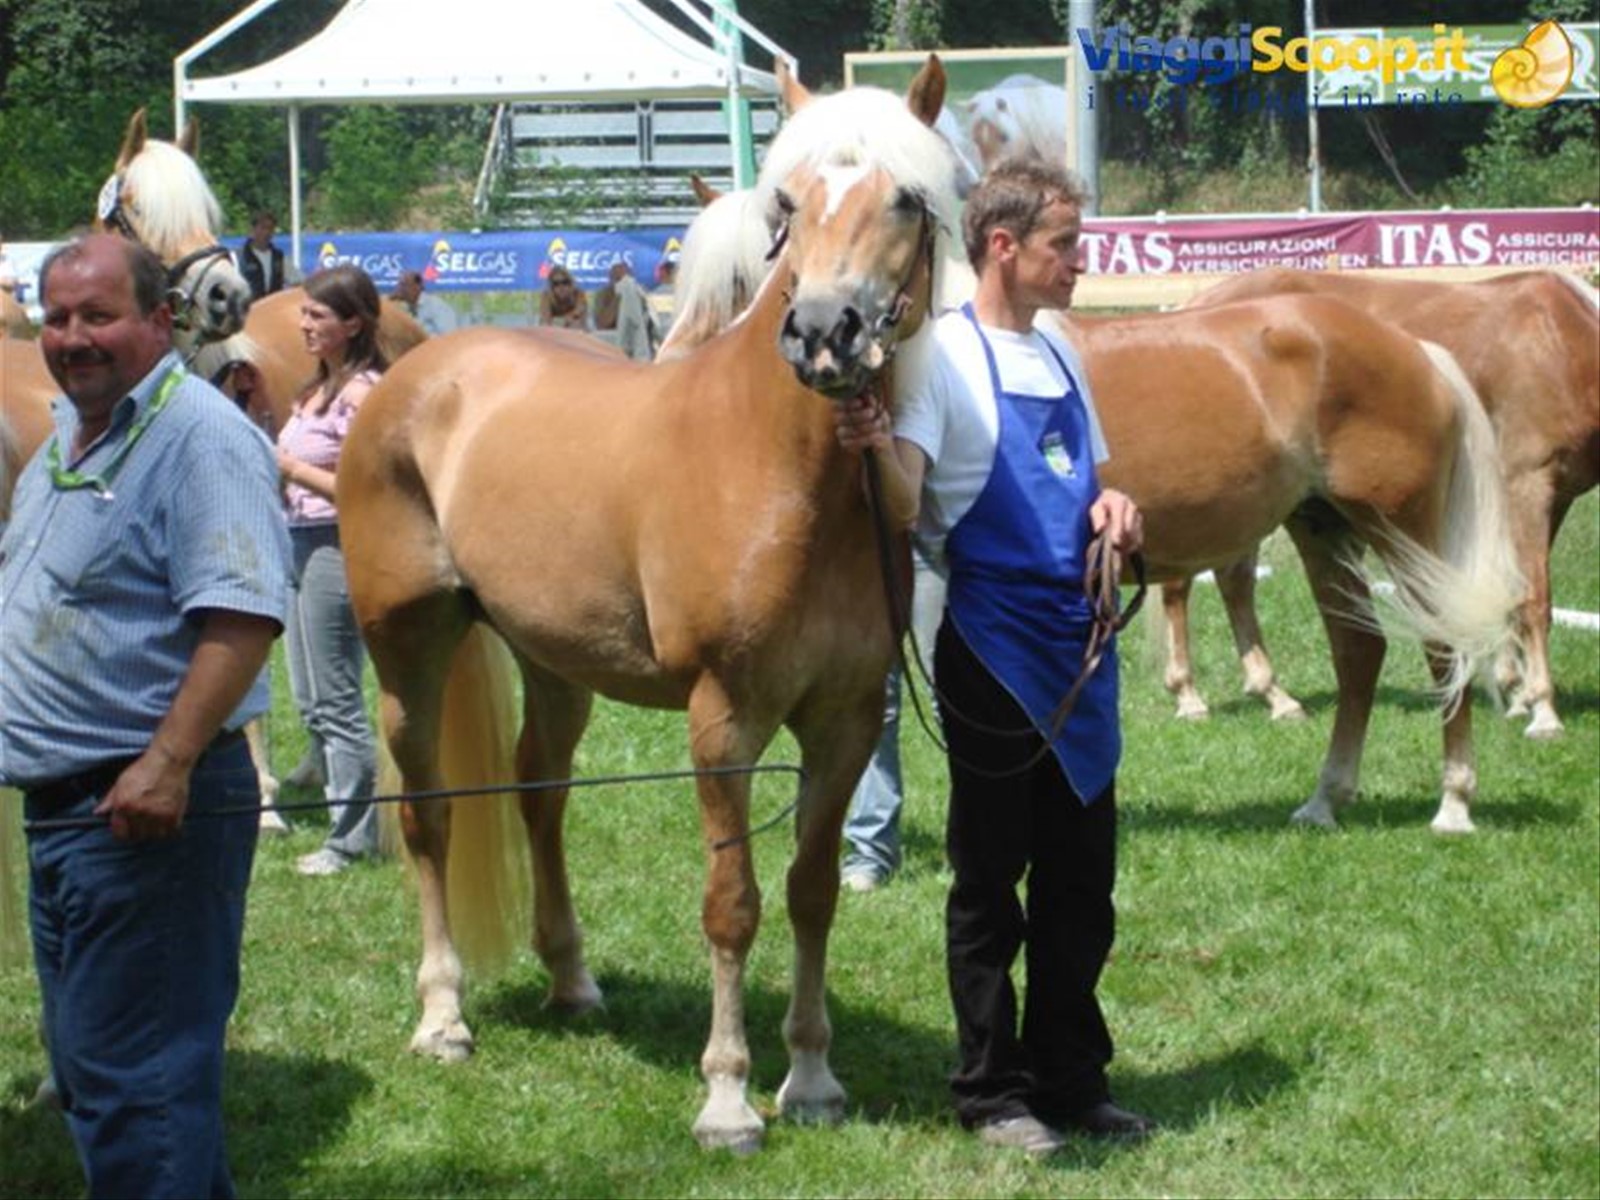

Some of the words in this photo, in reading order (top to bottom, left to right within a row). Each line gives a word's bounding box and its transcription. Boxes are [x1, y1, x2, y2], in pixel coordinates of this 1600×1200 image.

[1179, 236, 1336, 257] ASSICURAZIONI
[1378, 222, 1492, 266] ITAS
[436, 251, 518, 272] SELGAS
